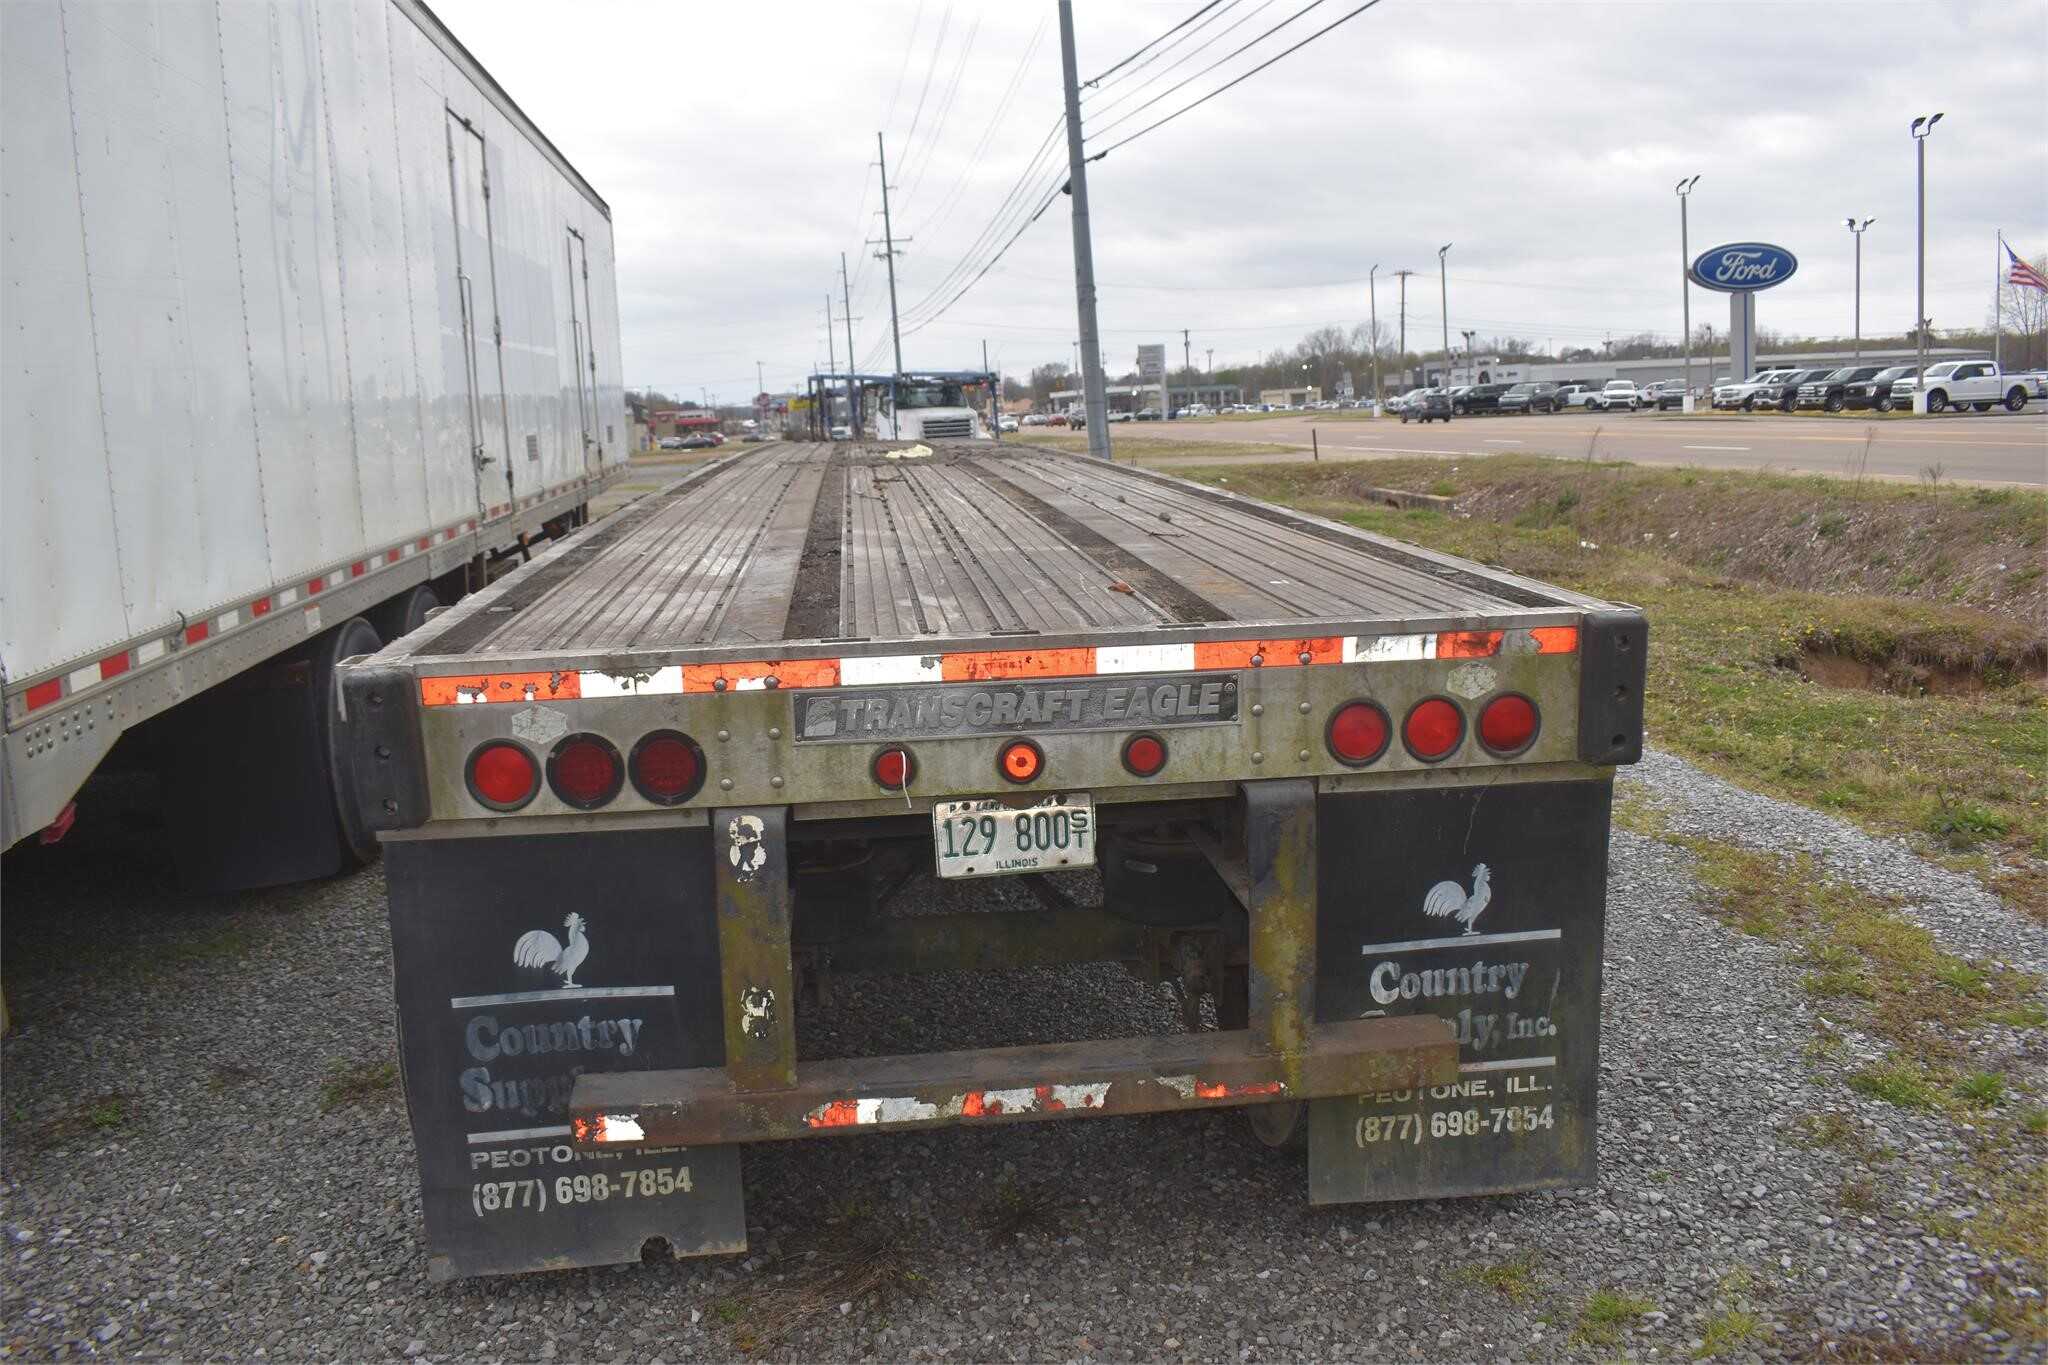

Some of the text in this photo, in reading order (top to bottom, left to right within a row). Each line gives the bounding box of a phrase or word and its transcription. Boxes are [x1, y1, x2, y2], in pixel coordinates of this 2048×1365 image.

[1716, 252, 1777, 281] Ford
[840, 683, 1223, 732] TRANSCRAFT EAGLE
[944, 815, 996, 857] 129
[1015, 810, 1070, 851] 800
[995, 857, 1039, 869] ILLINOIS
[1370, 960, 1529, 1005] Country
[466, 1015, 643, 1062] Country
[1506, 1011, 1557, 1040] Inc.
[1506, 1075, 1553, 1093] ILL.
[1355, 1105, 1554, 1148] (877) 698-7854
[472, 1166, 693, 1217] (877) 698-7854
